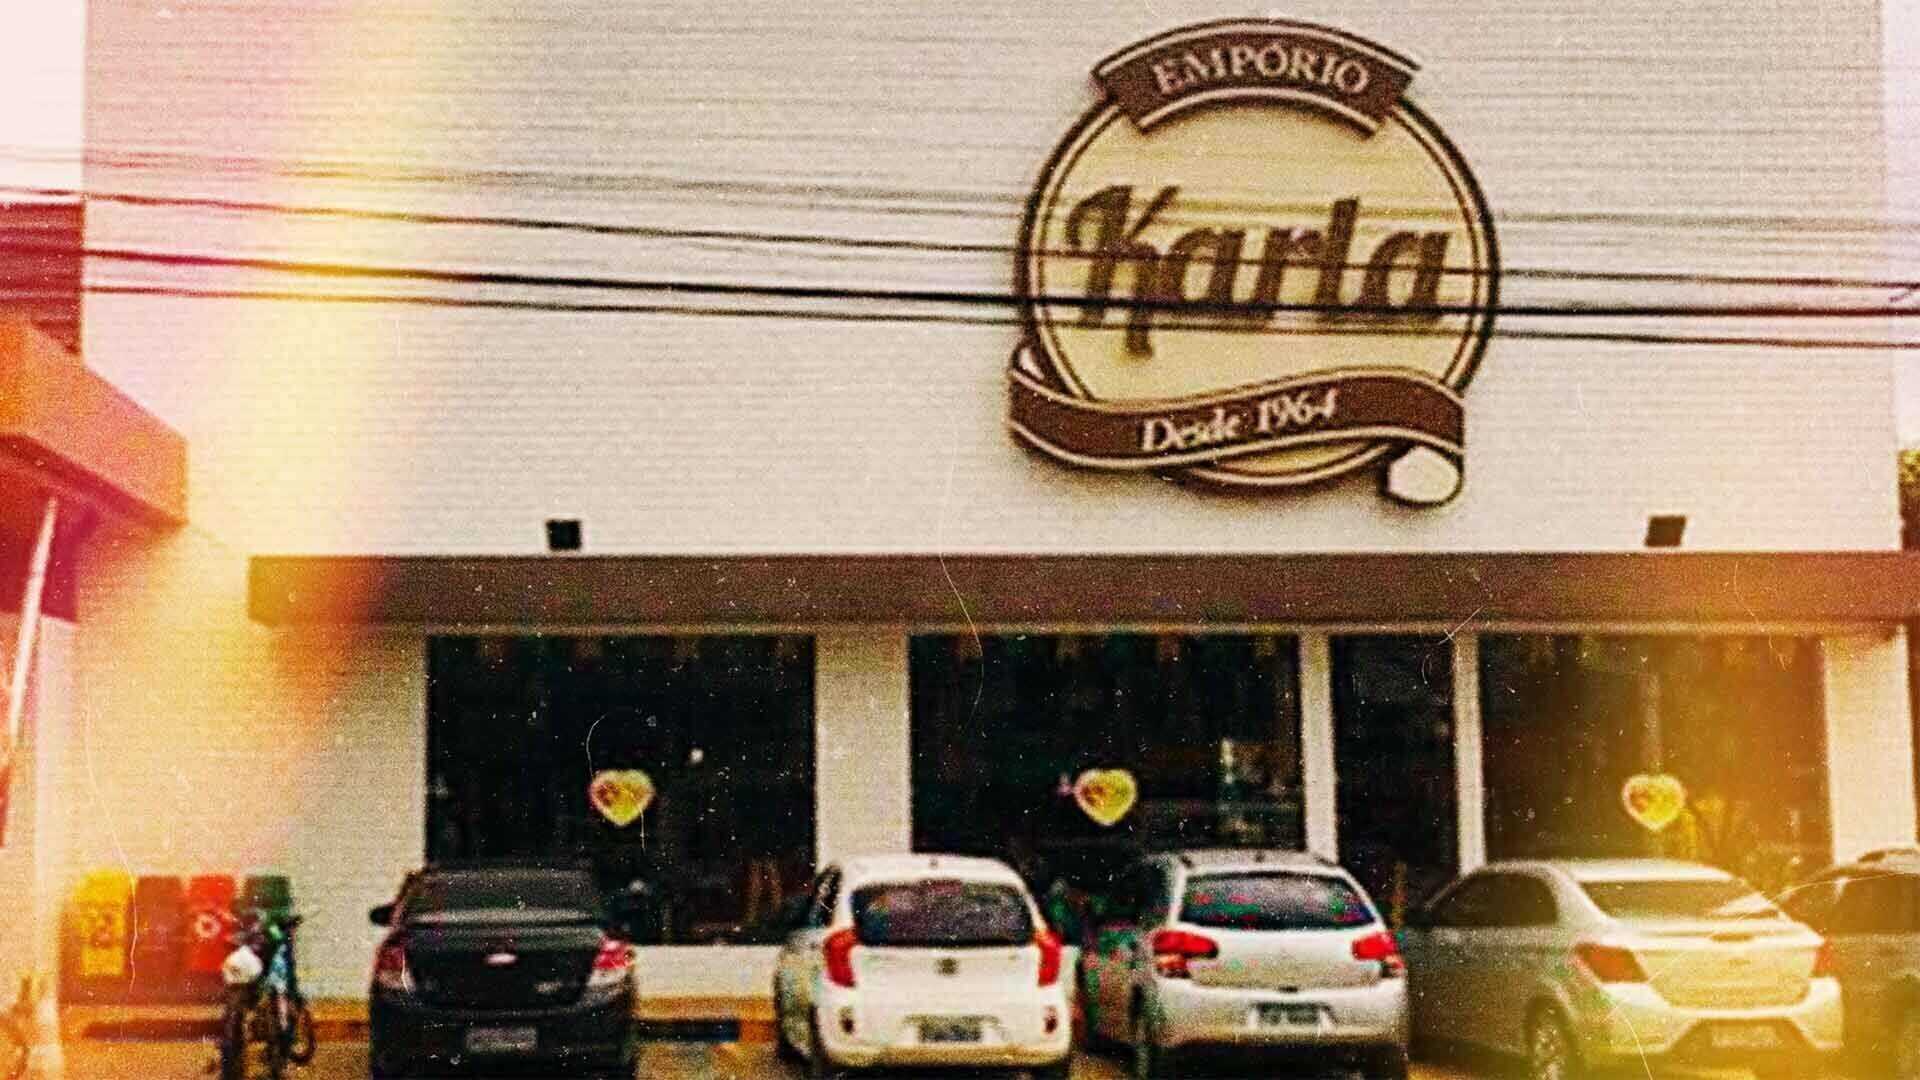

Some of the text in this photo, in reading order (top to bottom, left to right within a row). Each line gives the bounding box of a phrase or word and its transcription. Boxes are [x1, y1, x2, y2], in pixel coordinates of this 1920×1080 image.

[1153, 44, 1370, 94] EMPÓRIO
[1065, 185, 1451, 358] Karla
[1142, 388, 1338, 451] Desde 1964
